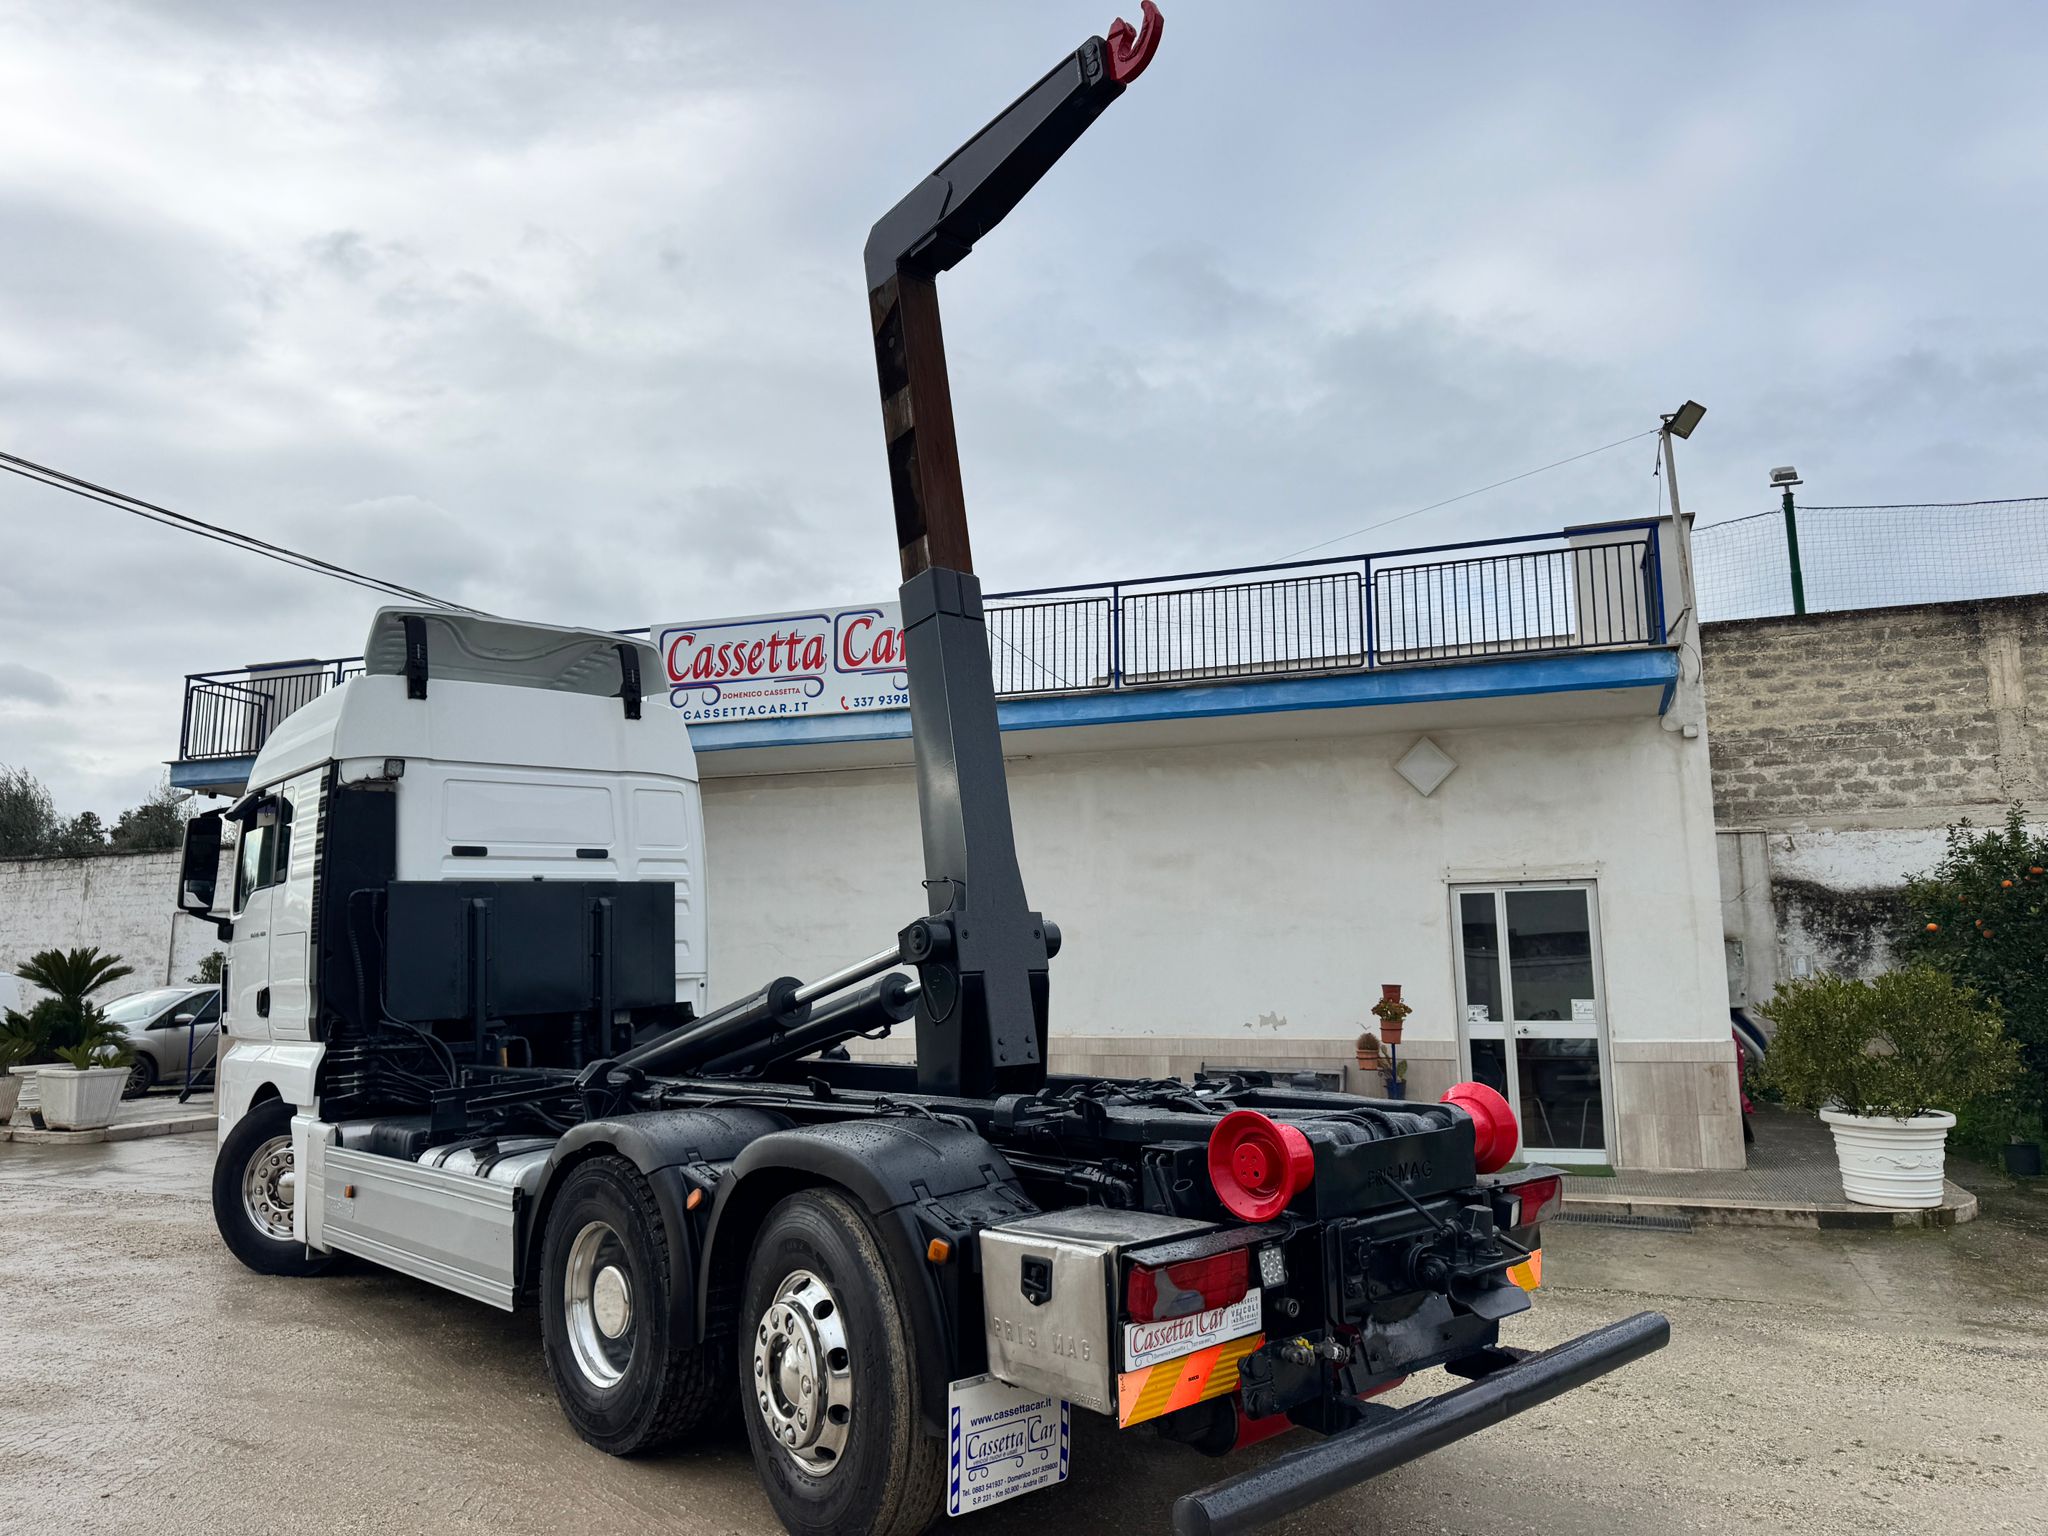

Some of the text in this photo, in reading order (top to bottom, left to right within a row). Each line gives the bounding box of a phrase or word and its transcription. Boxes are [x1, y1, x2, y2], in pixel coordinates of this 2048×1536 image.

[667, 629, 827, 682] Cassetta
[722, 688, 800, 700] DOMENICO CASSETTA
[853, 696, 874, 707] 337
[683, 702, 808, 720] CASSETTACAR.IT
[1133, 1309, 1225, 1354] Cassetta Car
[970, 1398, 1052, 1427] www.cassettacar.it
[968, 1419, 1056, 1459] Cassetta Car
[1007, 1471, 1031, 1484] Domenico
[982, 1493, 991, 1502] 231
[995, 1490, 1003, 1498] Km
